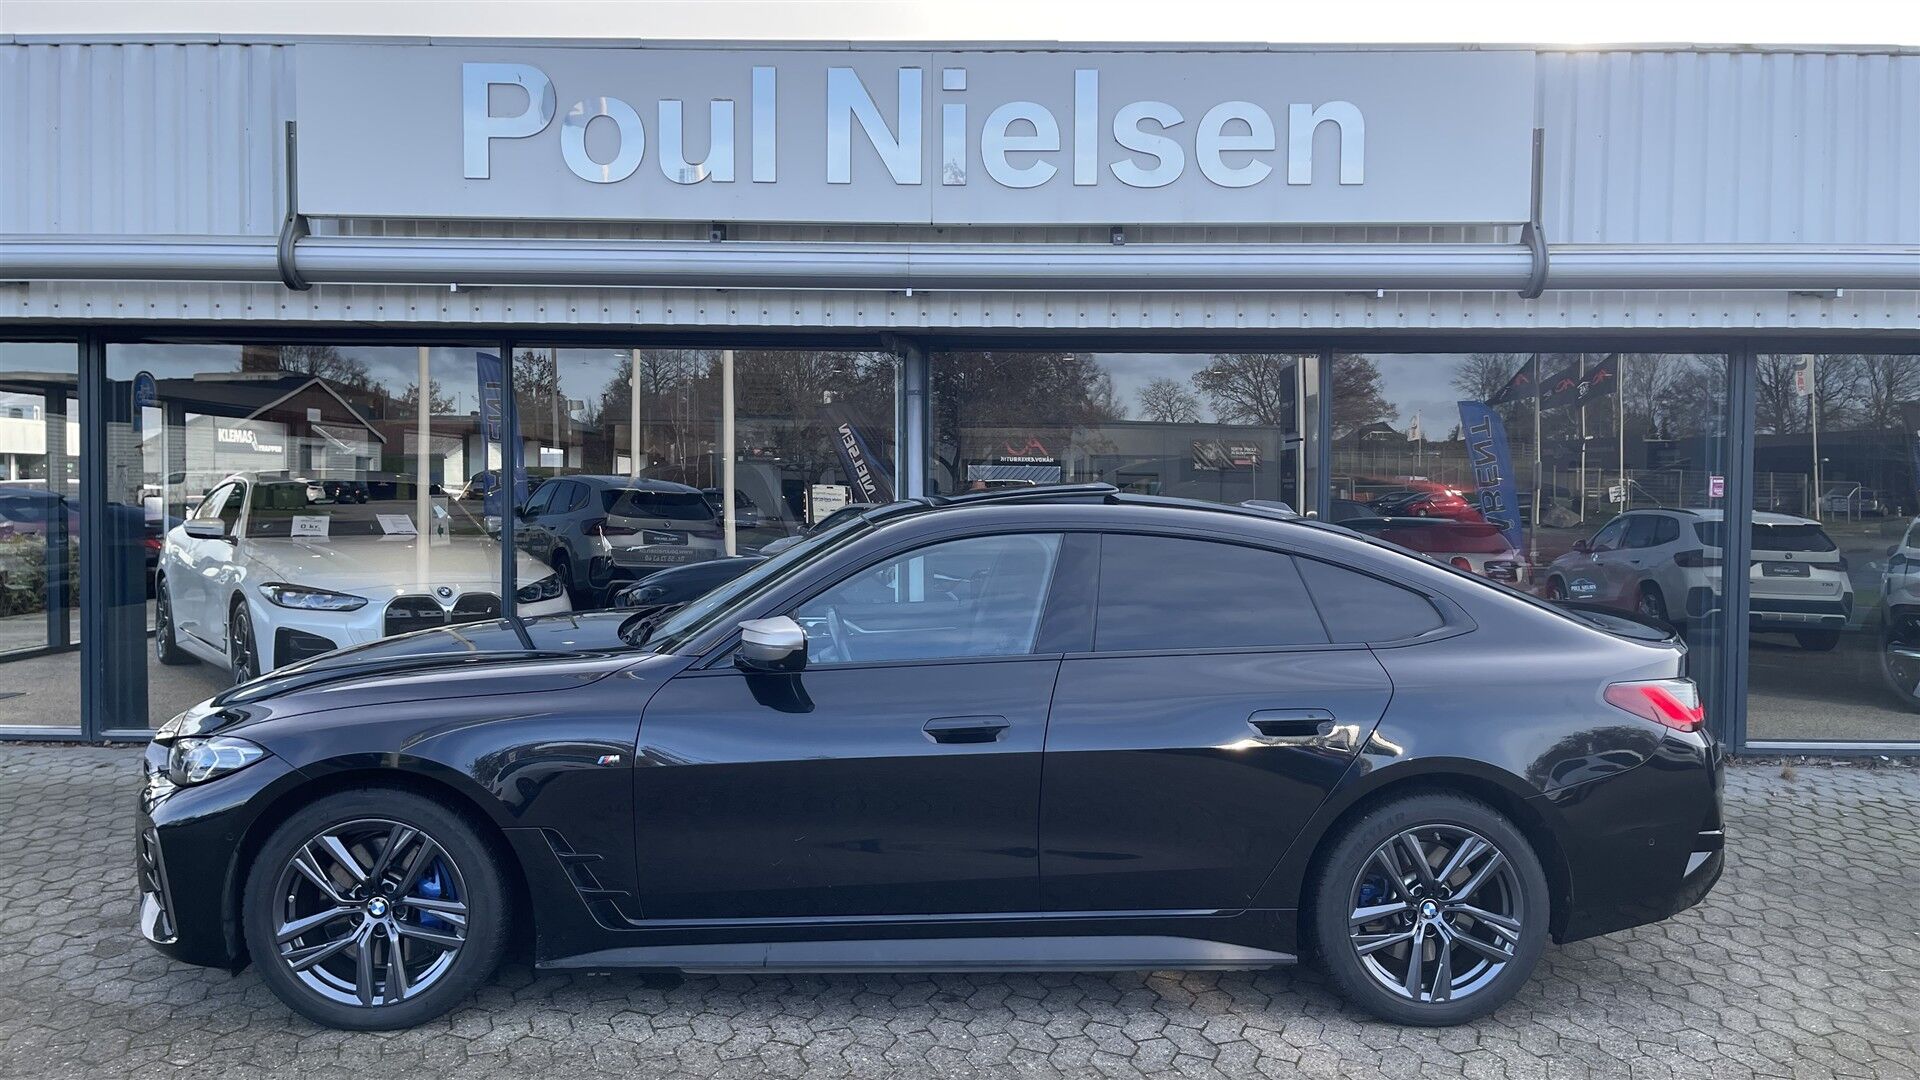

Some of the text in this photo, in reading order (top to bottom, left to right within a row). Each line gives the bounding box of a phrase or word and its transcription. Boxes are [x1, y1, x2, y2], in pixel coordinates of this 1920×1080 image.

[461, 61, 1367, 189] Poul Nielsen
[217, 428, 253, 444] KLEMAS
